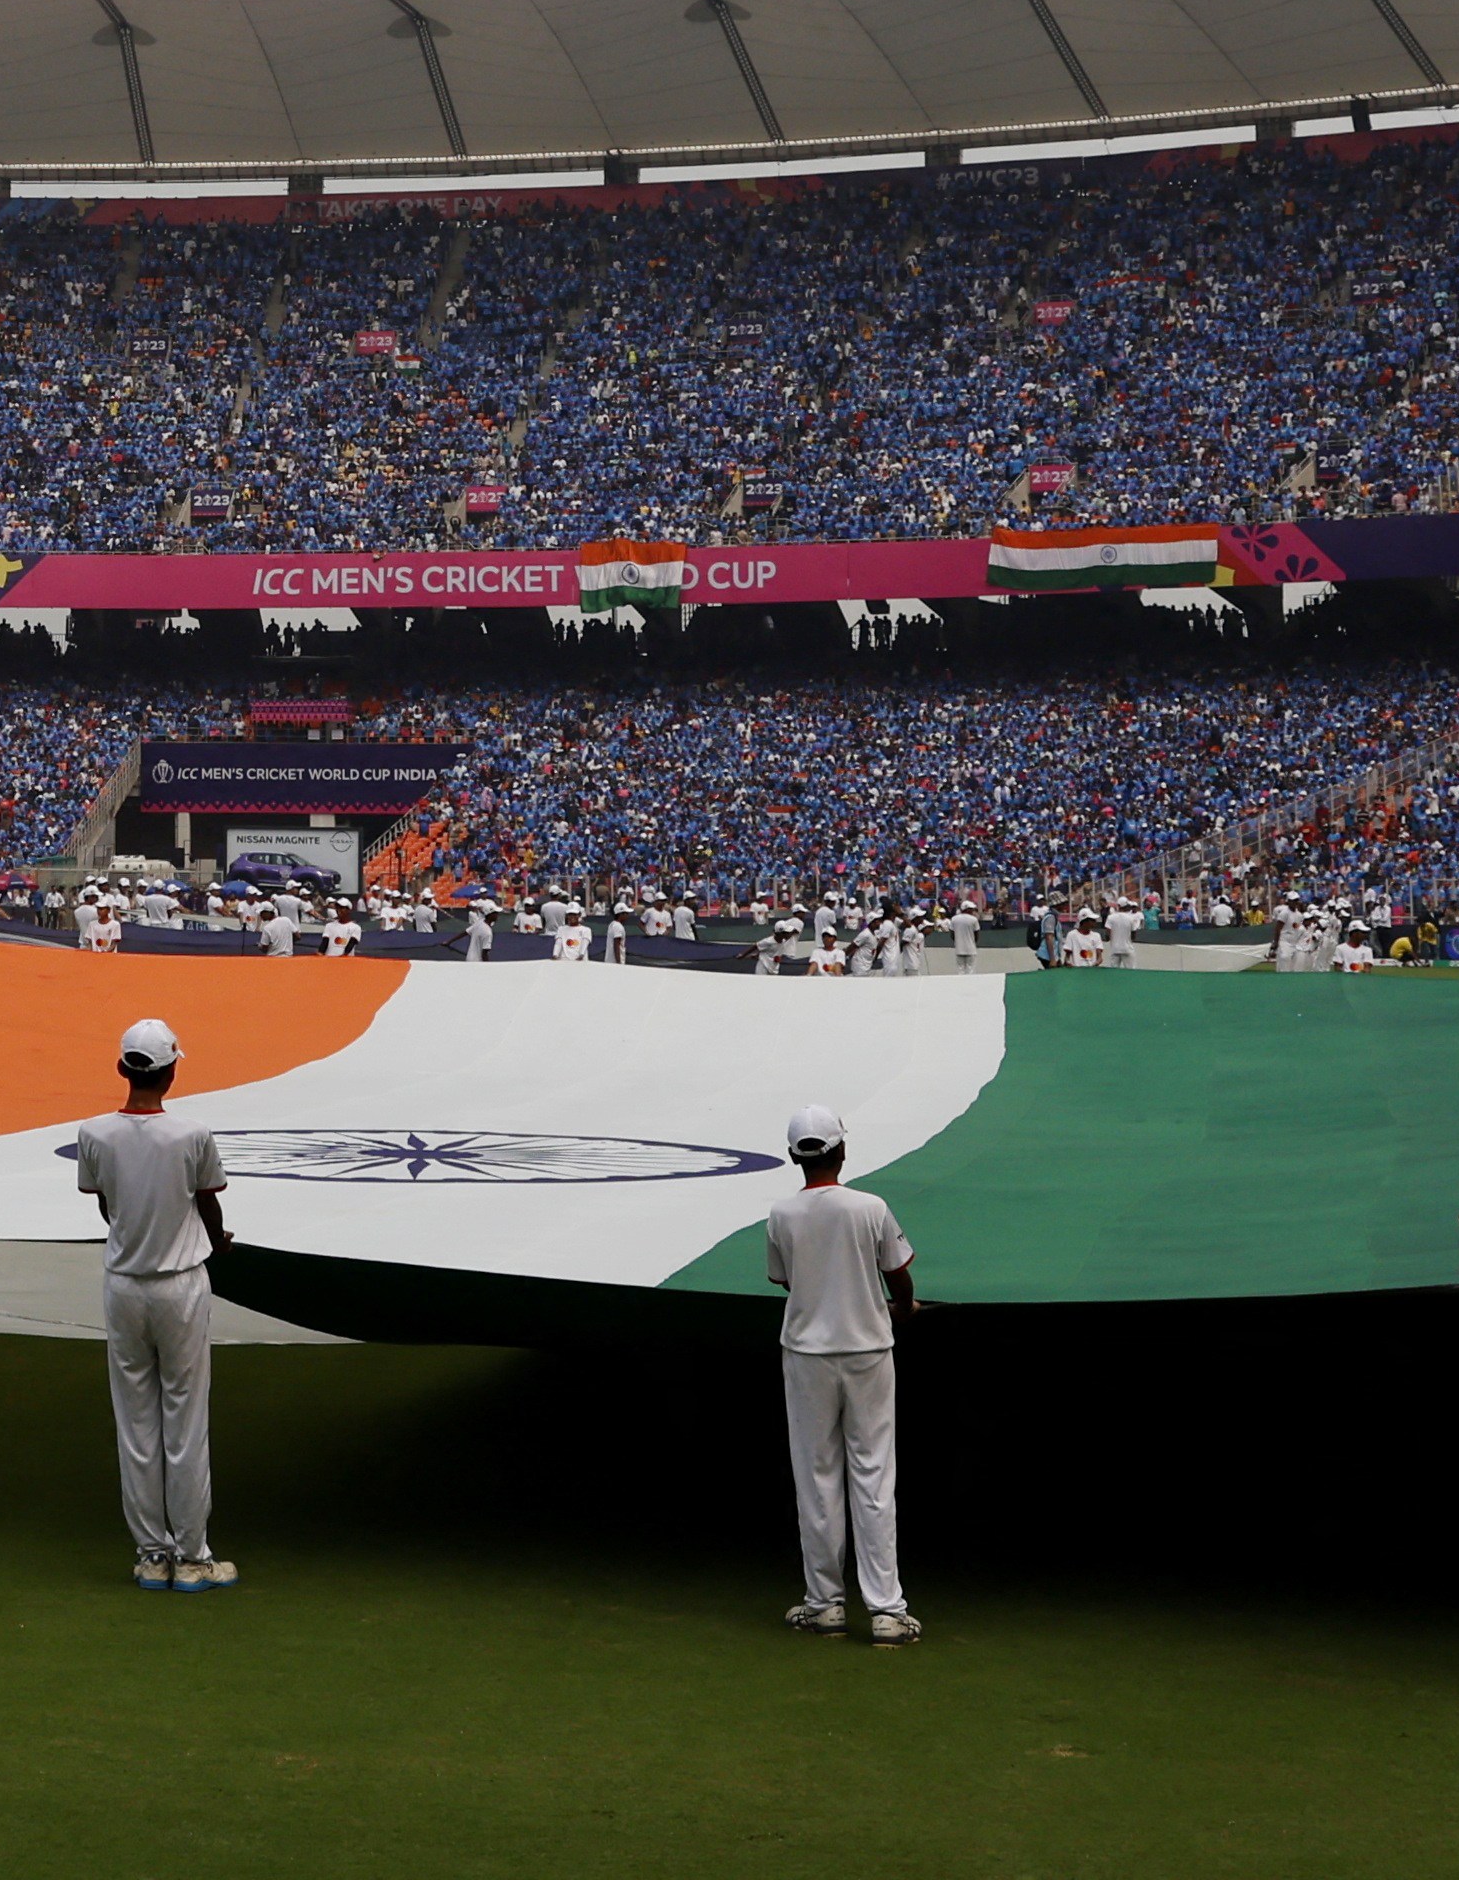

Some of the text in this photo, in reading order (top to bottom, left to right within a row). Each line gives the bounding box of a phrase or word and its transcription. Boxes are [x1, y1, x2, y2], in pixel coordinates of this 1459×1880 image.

[252, 568, 304, 595] ICC
[311, 566, 414, 595] MEN'S
[422, 565, 565, 594] CRICKET
[706, 561, 777, 590] CUP
[177, 768, 438, 781] ICC MEN'S CRICKET WORLD CUP INDIA
[236, 835, 320, 845] NISSAN MAGNITE
